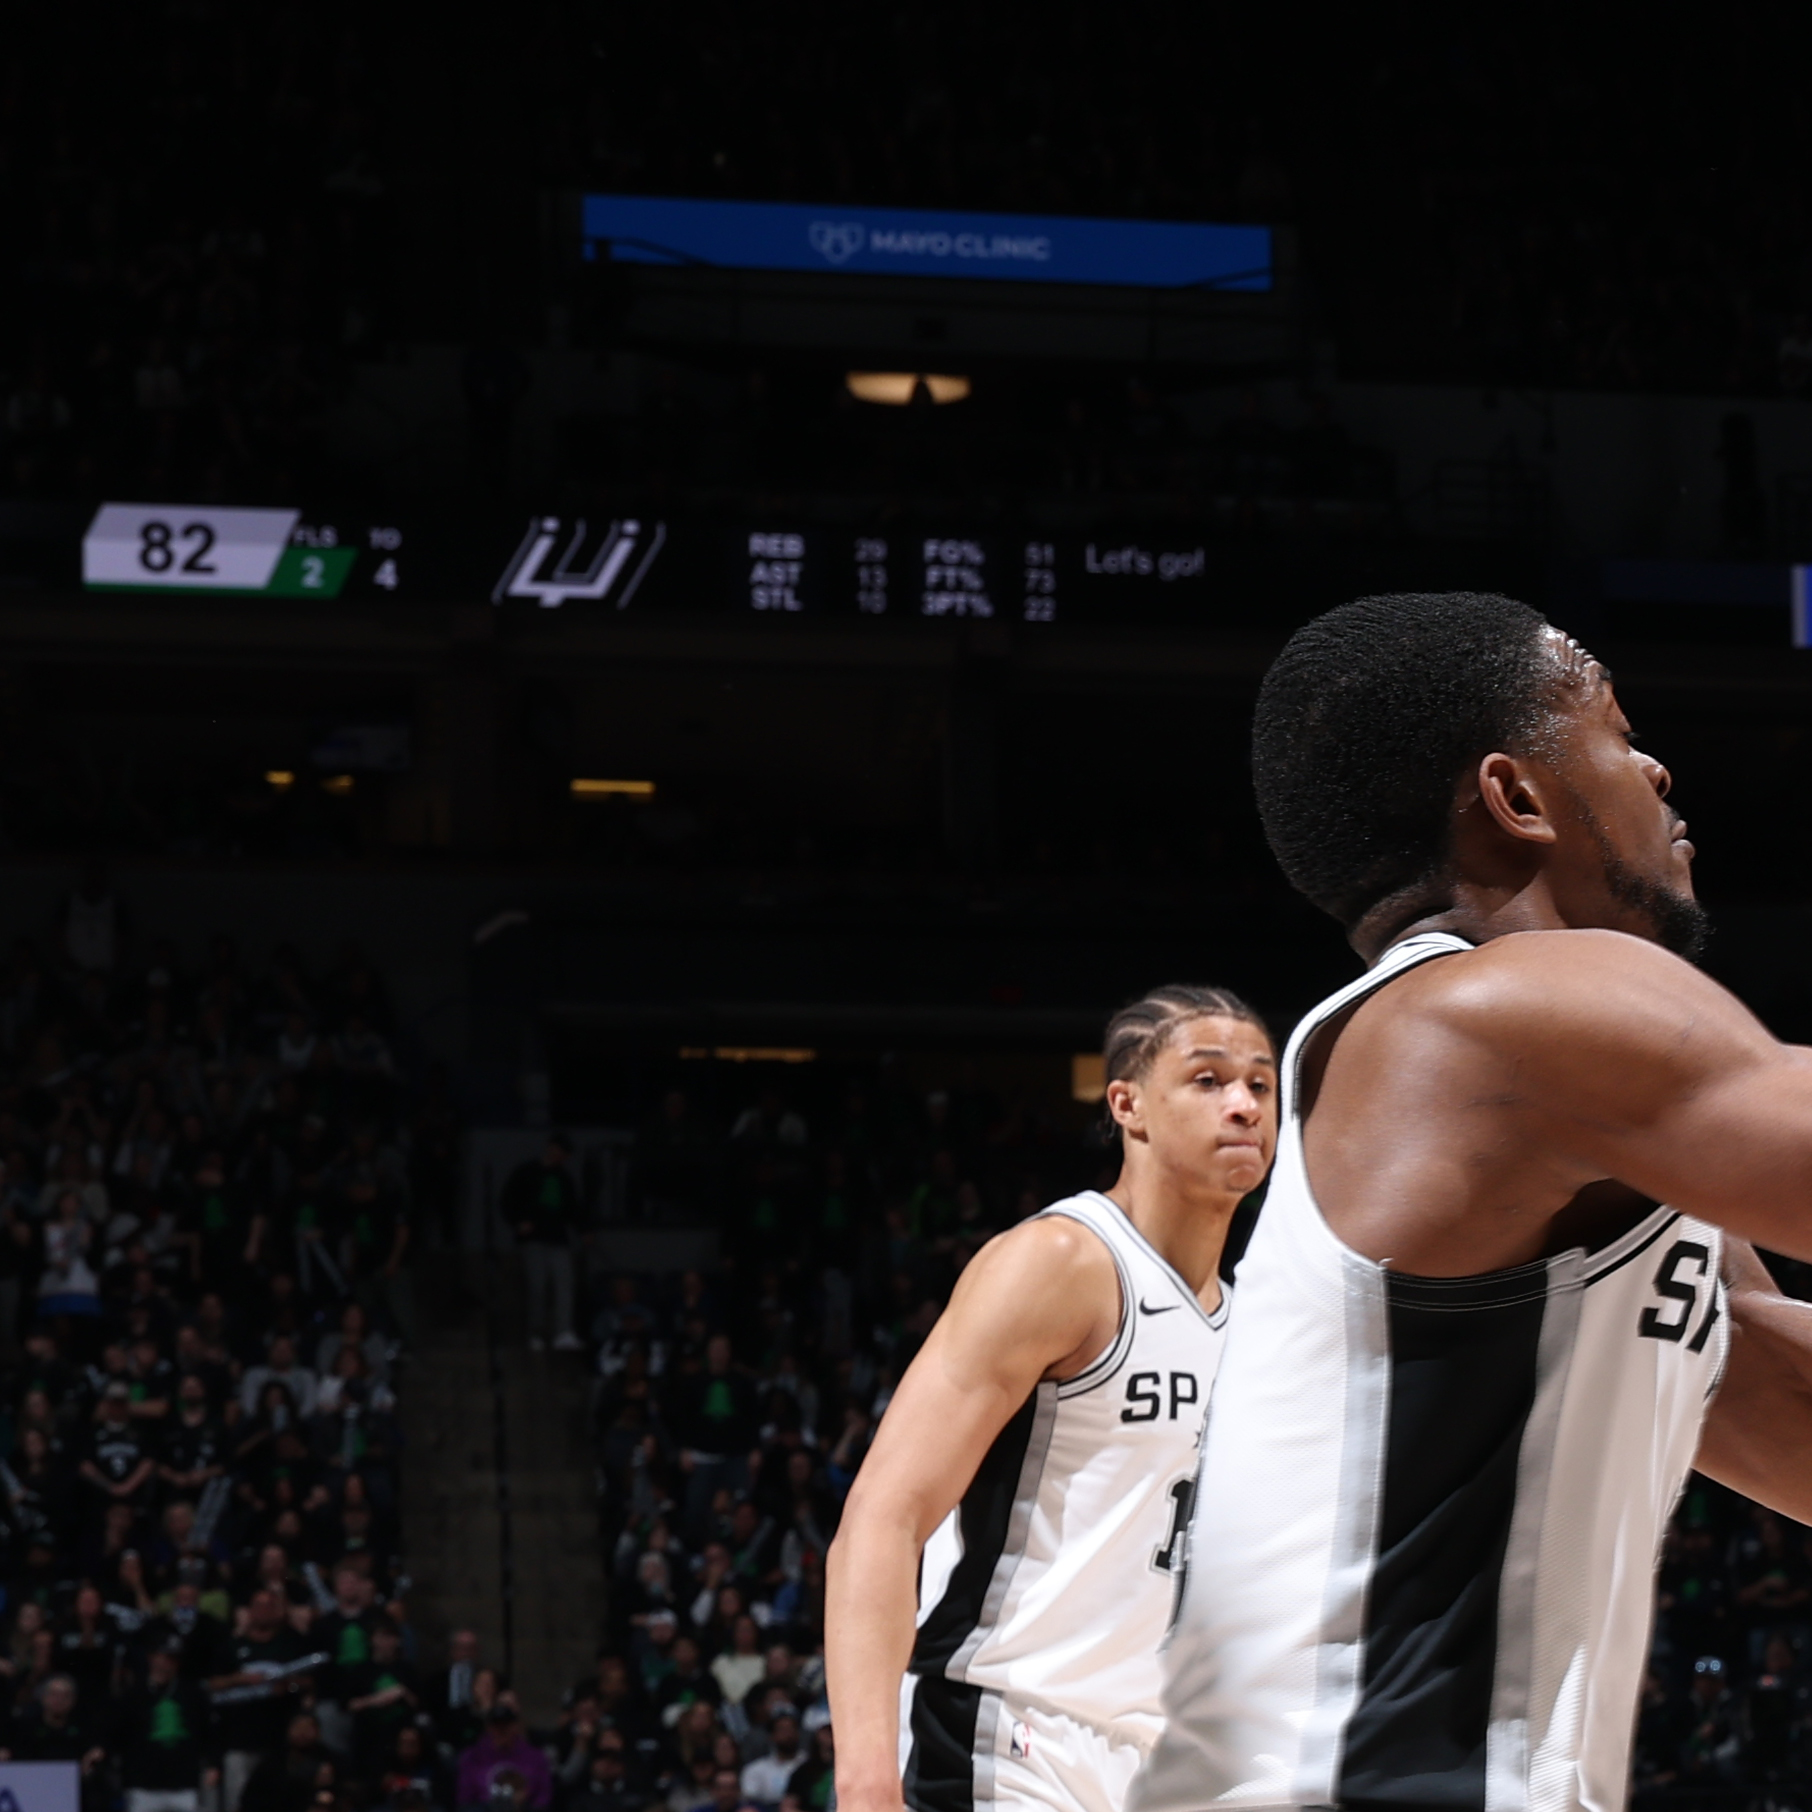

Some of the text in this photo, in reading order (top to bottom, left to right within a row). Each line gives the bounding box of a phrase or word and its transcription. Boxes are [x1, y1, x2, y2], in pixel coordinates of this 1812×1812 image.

[870, 229, 1051, 261] MAYO CLINIC
[140, 521, 216, 573] 82
[748, 531, 805, 559] REB
[301, 554, 400, 591] 2 4
[748, 560, 804, 586] AST
[1085, 542, 1206, 582] Let's go!
[750, 586, 804, 612] STL
